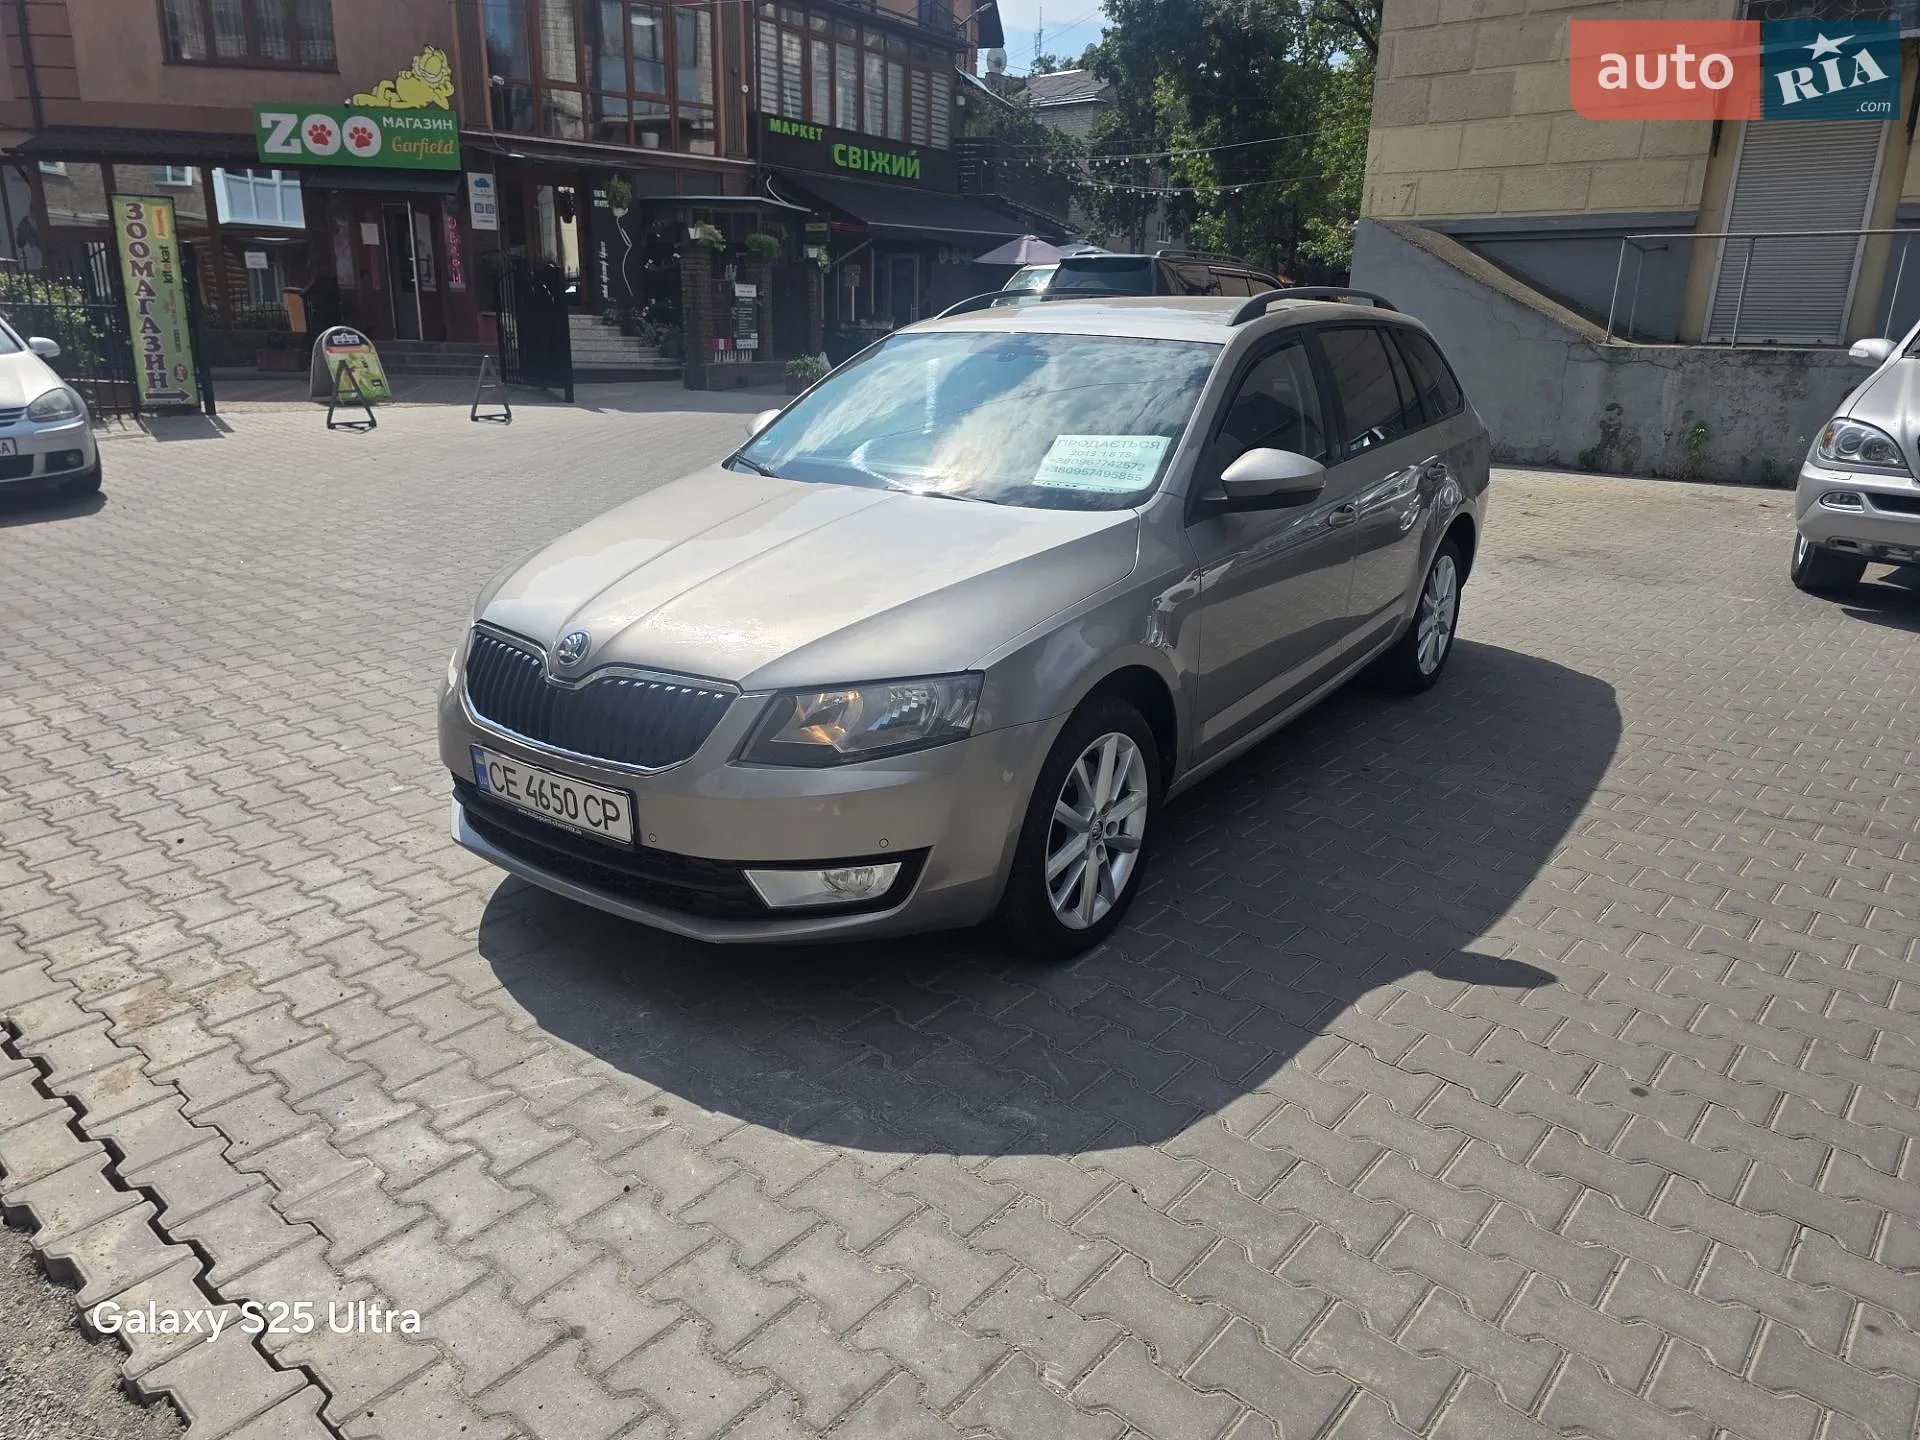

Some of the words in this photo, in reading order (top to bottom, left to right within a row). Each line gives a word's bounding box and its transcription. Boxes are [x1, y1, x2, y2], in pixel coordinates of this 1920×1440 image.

[260, 112, 382, 158] ZOO
[382, 116, 453, 130] МАГАЗИН
[769, 118, 823, 141] МАРКЕТ
[392, 135, 455, 161] Garfield
[832, 143, 921, 180] СВІЖИЙ
[125, 202, 169, 389] ЗООМАГАЗИН
[1056, 439, 1161, 449] ПРОДАЄТЬСЯ
[489, 761, 521, 800] CE
[525, 775, 579, 820] 4650
[583, 794, 621, 831] CP
